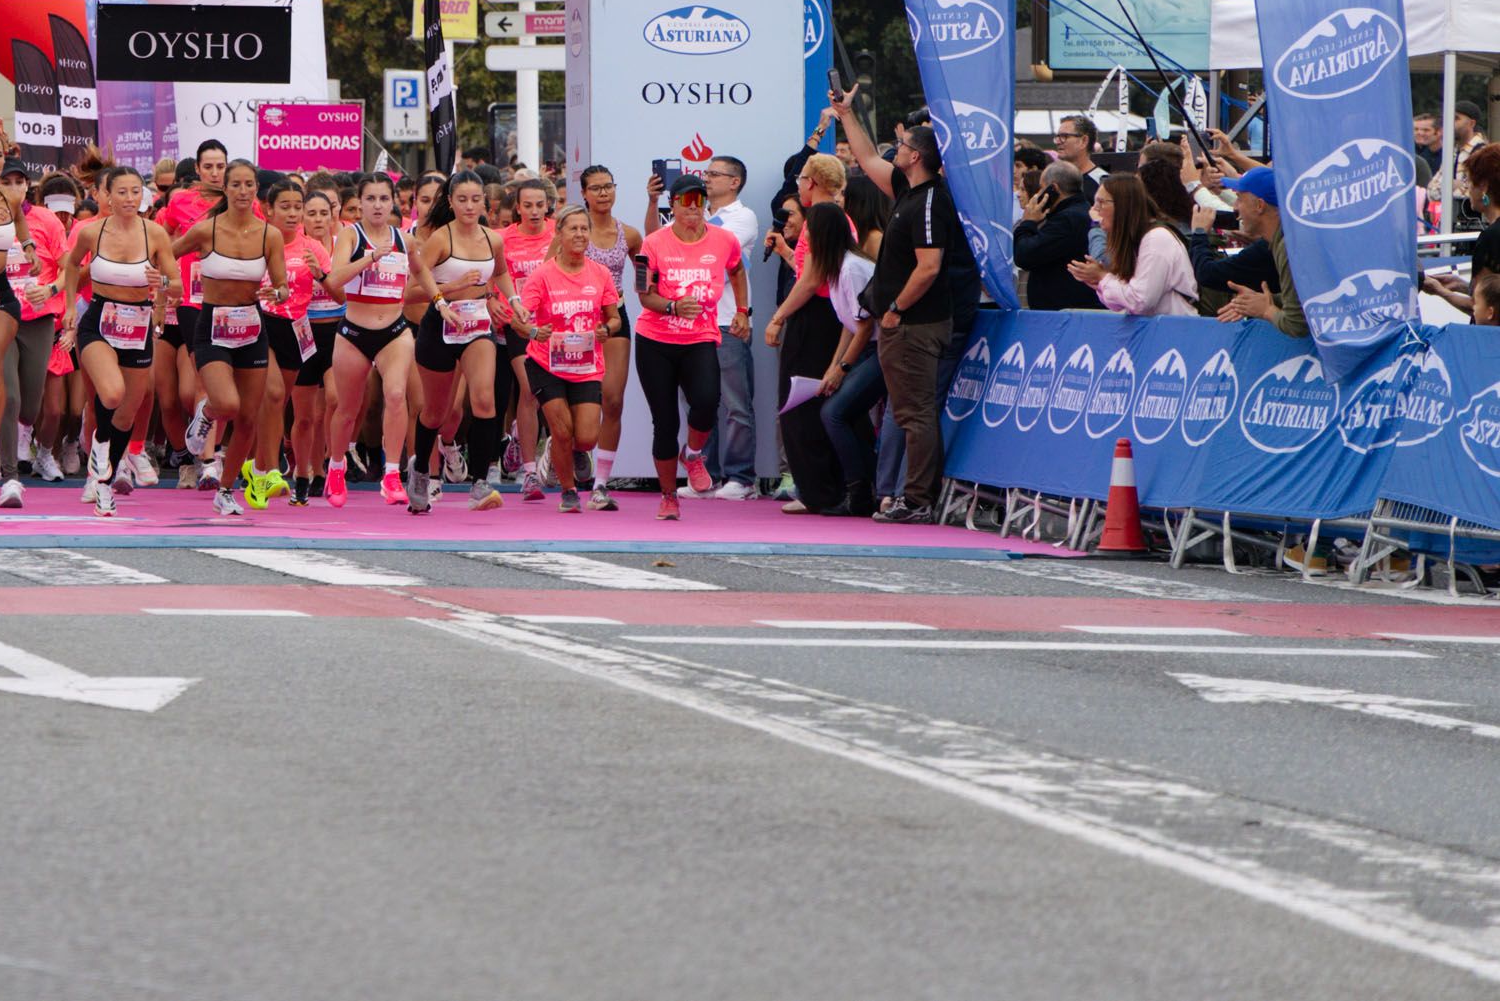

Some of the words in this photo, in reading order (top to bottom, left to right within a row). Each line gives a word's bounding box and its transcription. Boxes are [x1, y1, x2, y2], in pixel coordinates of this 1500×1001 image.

[651, 23, 743, 43] ASTURIANA
[128, 30, 263, 61] OYSHO
[641, 81, 753, 106] OYSHO
[318, 111, 359, 123] OYSHO
[259, 134, 360, 151] CORREDORAS
[379, 270, 397, 281] 016
[667, 268, 712, 282] CARRERA
[552, 300, 594, 315] CARRERA
[565, 350, 584, 360] 016
[1246, 388, 1329, 430] ASTURIANA
